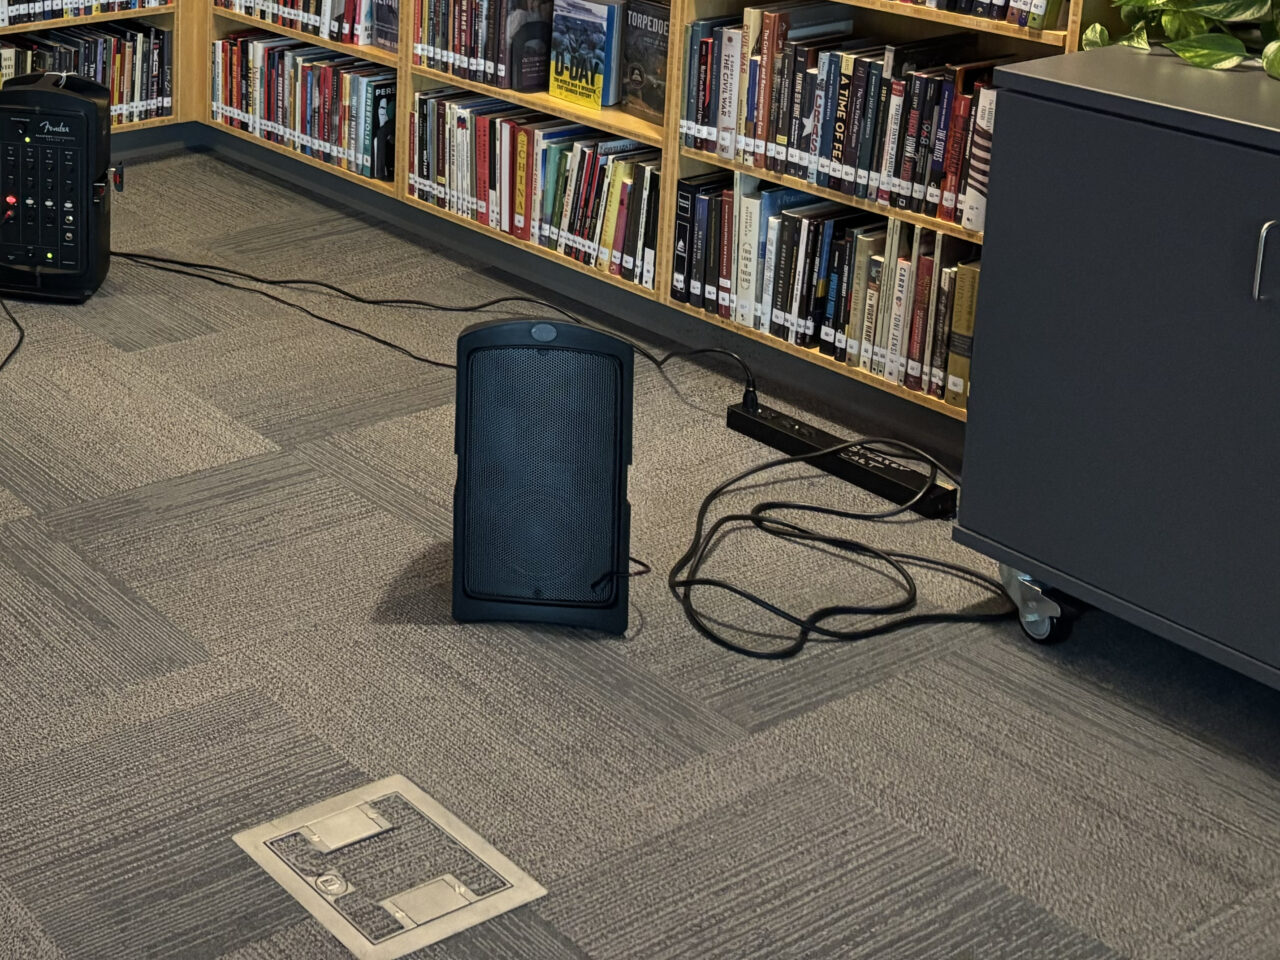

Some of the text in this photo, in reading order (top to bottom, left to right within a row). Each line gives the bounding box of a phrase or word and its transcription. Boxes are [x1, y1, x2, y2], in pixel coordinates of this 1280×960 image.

[627, 10, 669, 36] TORPEDOE
[720, 54, 731, 117] THE CIVIL WAR
[40, 120, 70, 133] Fender
[364, 86, 373, 145] PERSEPOLIS
[831, 76, 849, 164] A TIME OF FEA
[919, 120, 930, 145] 1968
[933, 142, 945, 162] SIXTIES
[892, 266, 907, 332] CARRY TONI
[864, 302, 876, 342] WORST HARD
